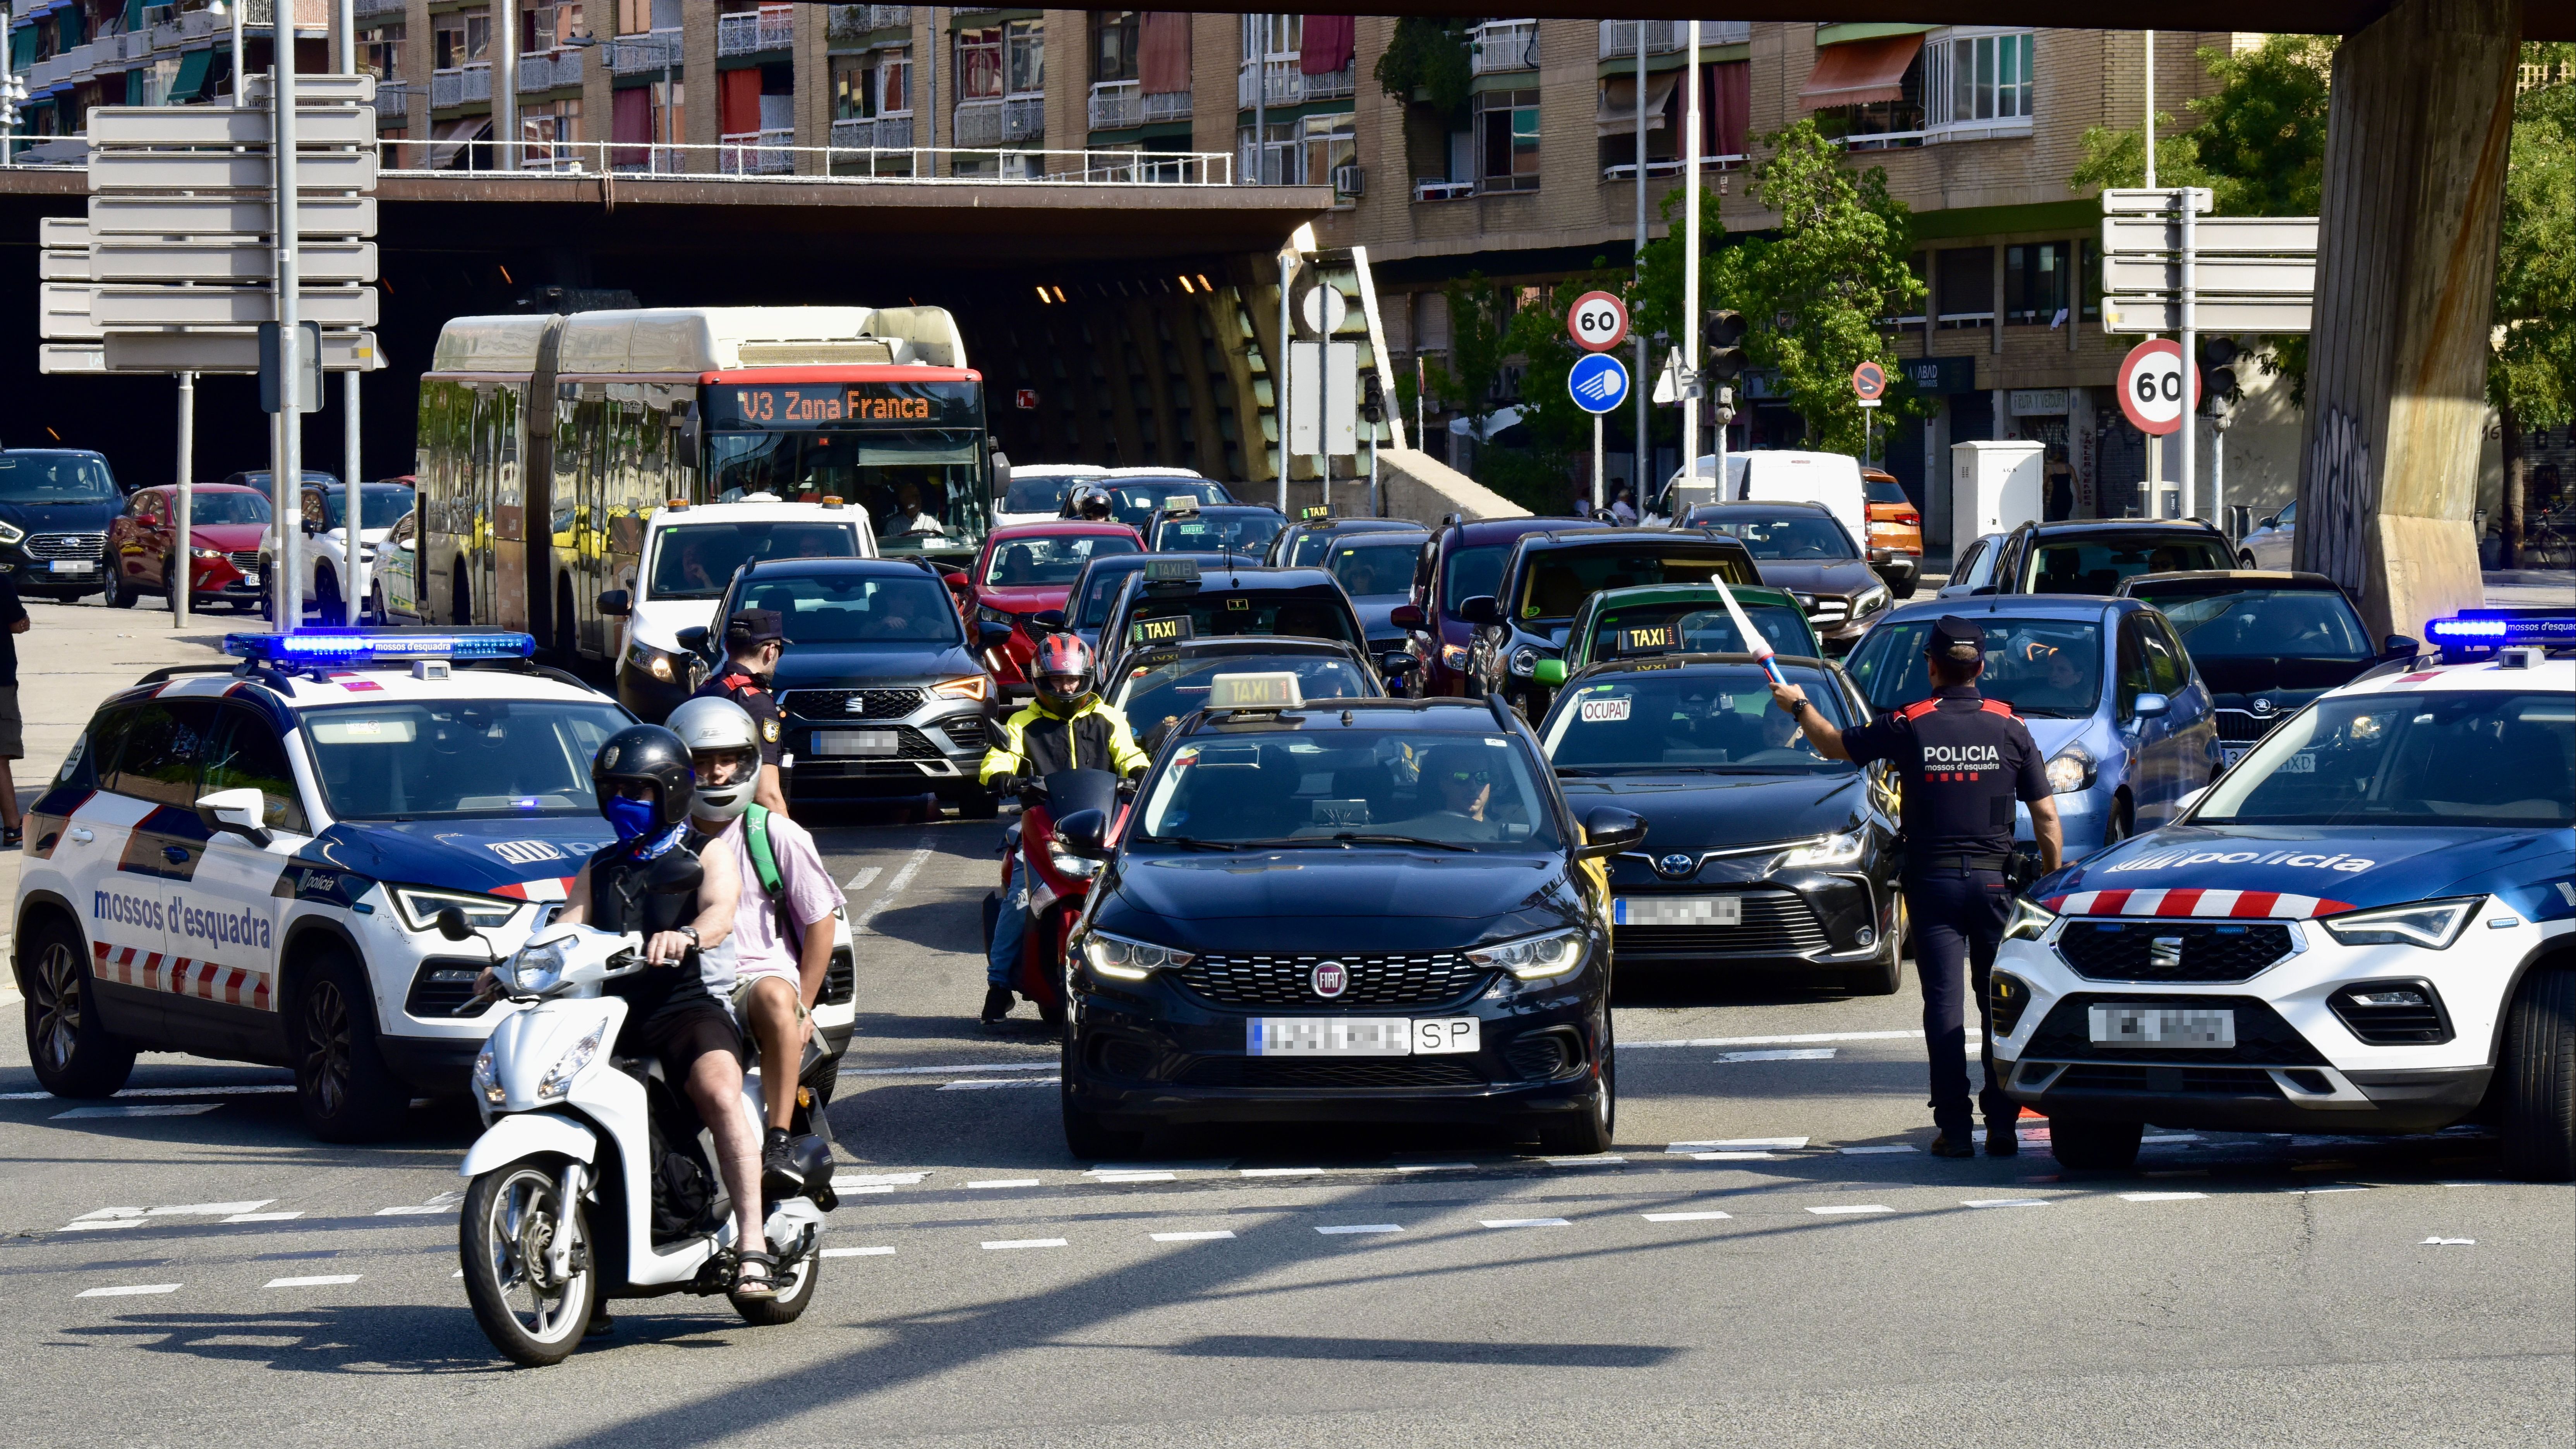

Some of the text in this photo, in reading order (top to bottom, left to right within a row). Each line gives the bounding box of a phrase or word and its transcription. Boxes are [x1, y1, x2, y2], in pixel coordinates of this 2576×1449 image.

[1581, 312, 1614, 331] 60
[1918, 365, 1937, 379] ABAD
[2137, 371, 2180, 402] 60
[744, 391, 928, 420] V3 Zona Franca
[2015, 393, 2065, 409] FRUTA Y VERDURA
[1172, 499, 1186, 508] TAXI
[1309, 506, 1328, 517] TAXI
[1157, 563, 1180, 576] TAXI
[1145, 621, 1176, 639] TAXI
[1630, 628, 1665, 647] TAXI
[407, 642, 451, 652] d'esquadra
[1231, 681, 1287, 702] TAXI 1
[1585, 702, 1627, 719] OCUPAT
[68, 745, 82, 761] 112
[1924, 745, 1999, 762] POLICIA
[1957, 762, 1999, 771] d'esquadra
[2173, 850, 2375, 872] policia
[304, 875, 334, 891] policia
[94, 890, 270, 949] mossos d'esquadra
[1320, 972, 1340, 988] FIAT
